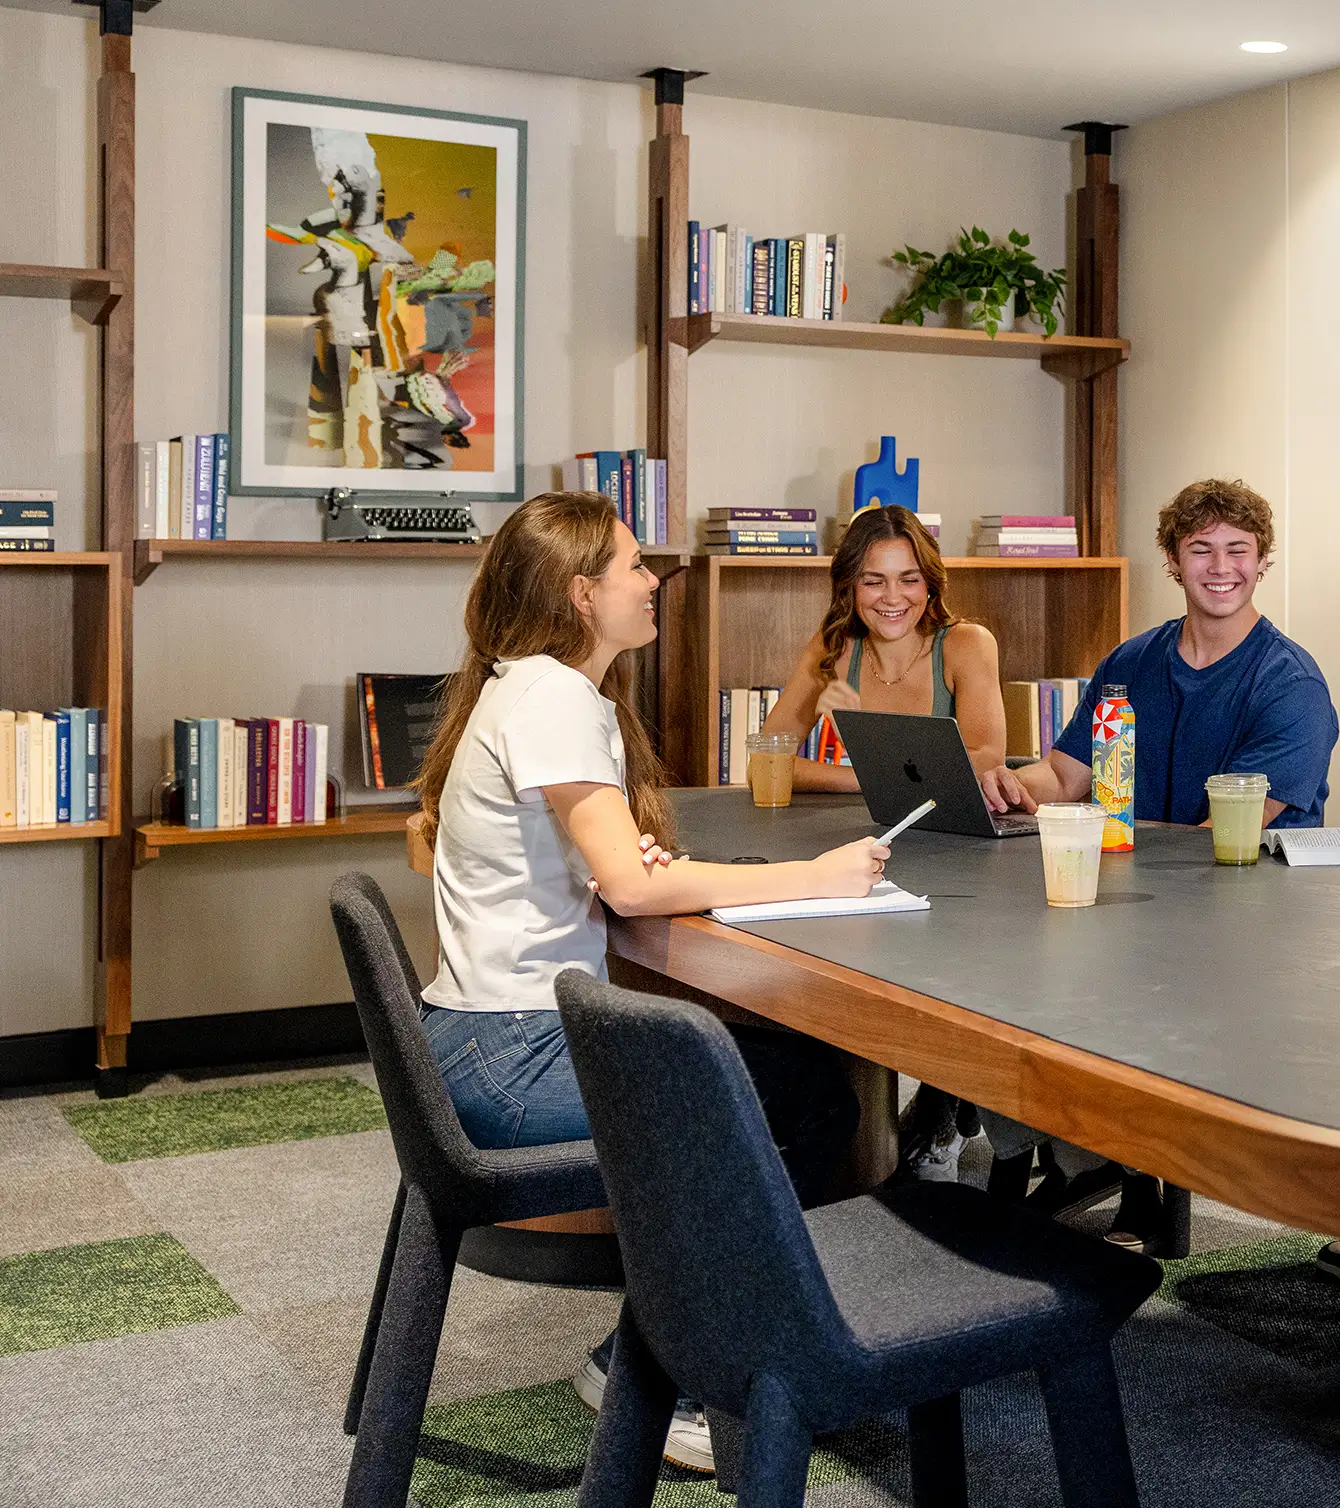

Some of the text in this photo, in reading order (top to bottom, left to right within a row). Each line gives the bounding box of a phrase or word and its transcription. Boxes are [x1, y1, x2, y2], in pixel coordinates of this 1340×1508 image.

[792, 250, 800, 284] STARDUST
[218, 459, 227, 474] Wild
[218, 476, 226, 488] and
[611, 471, 619, 501] LOCKED
[216, 489, 225, 505] Crazy
[216, 507, 225, 523] Guys
[1112, 796, 1132, 804] PATH
